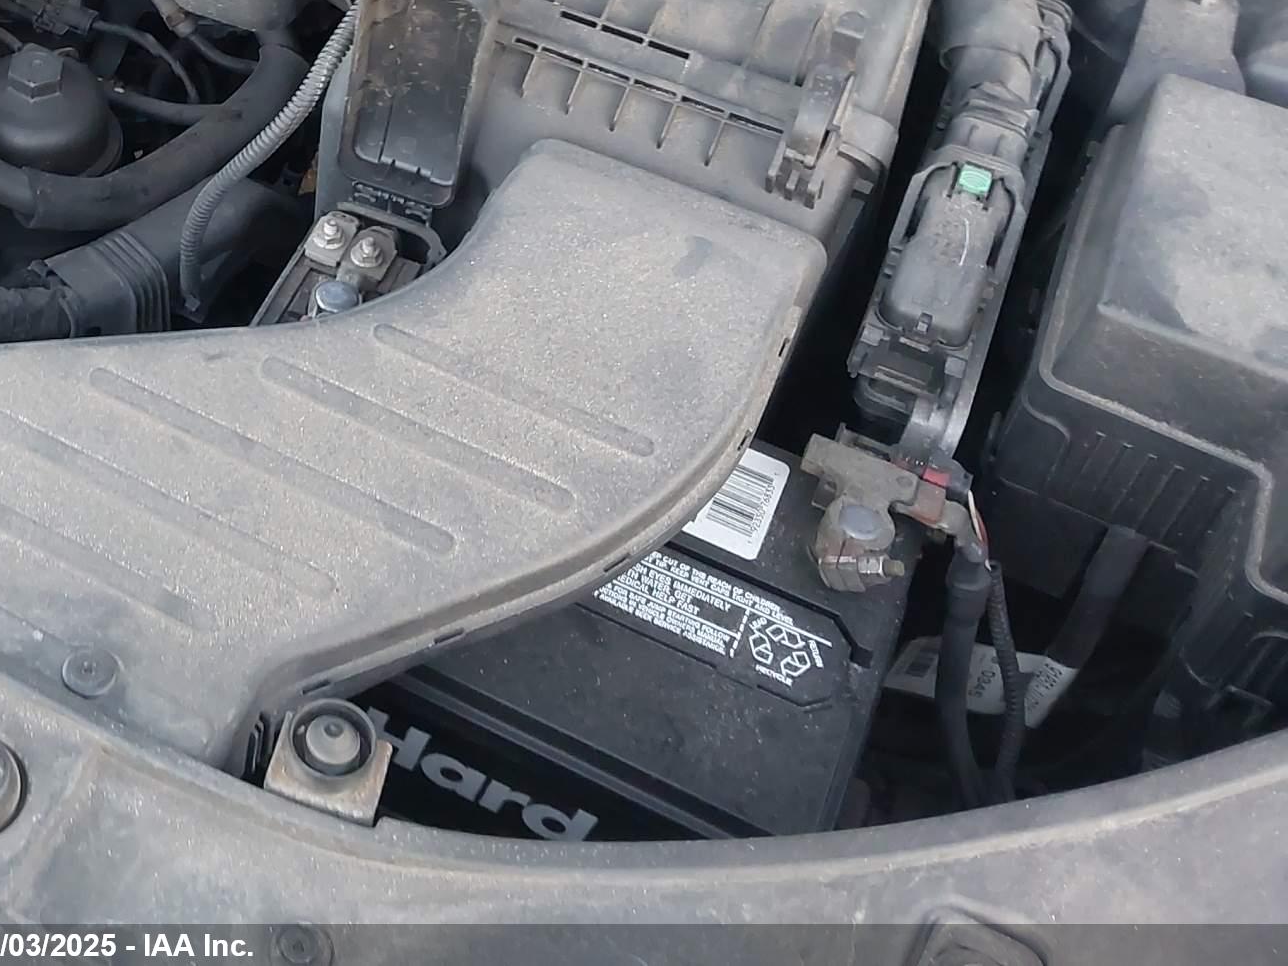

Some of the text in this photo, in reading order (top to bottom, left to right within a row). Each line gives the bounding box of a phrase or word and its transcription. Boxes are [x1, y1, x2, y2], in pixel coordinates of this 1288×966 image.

[648, 569, 674, 586] EYES
[673, 580, 731, 612] IMMEDIATELY
[706, 575, 732, 592] REACH
[652, 588, 678, 604] HELP
[676, 599, 700, 615] FAST
[672, 589, 694, 605] GET
[667, 608, 701, 629] STARTING
[700, 624, 730, 642] FOLLOW
[755, 664, 794, 687] RECYCLE
